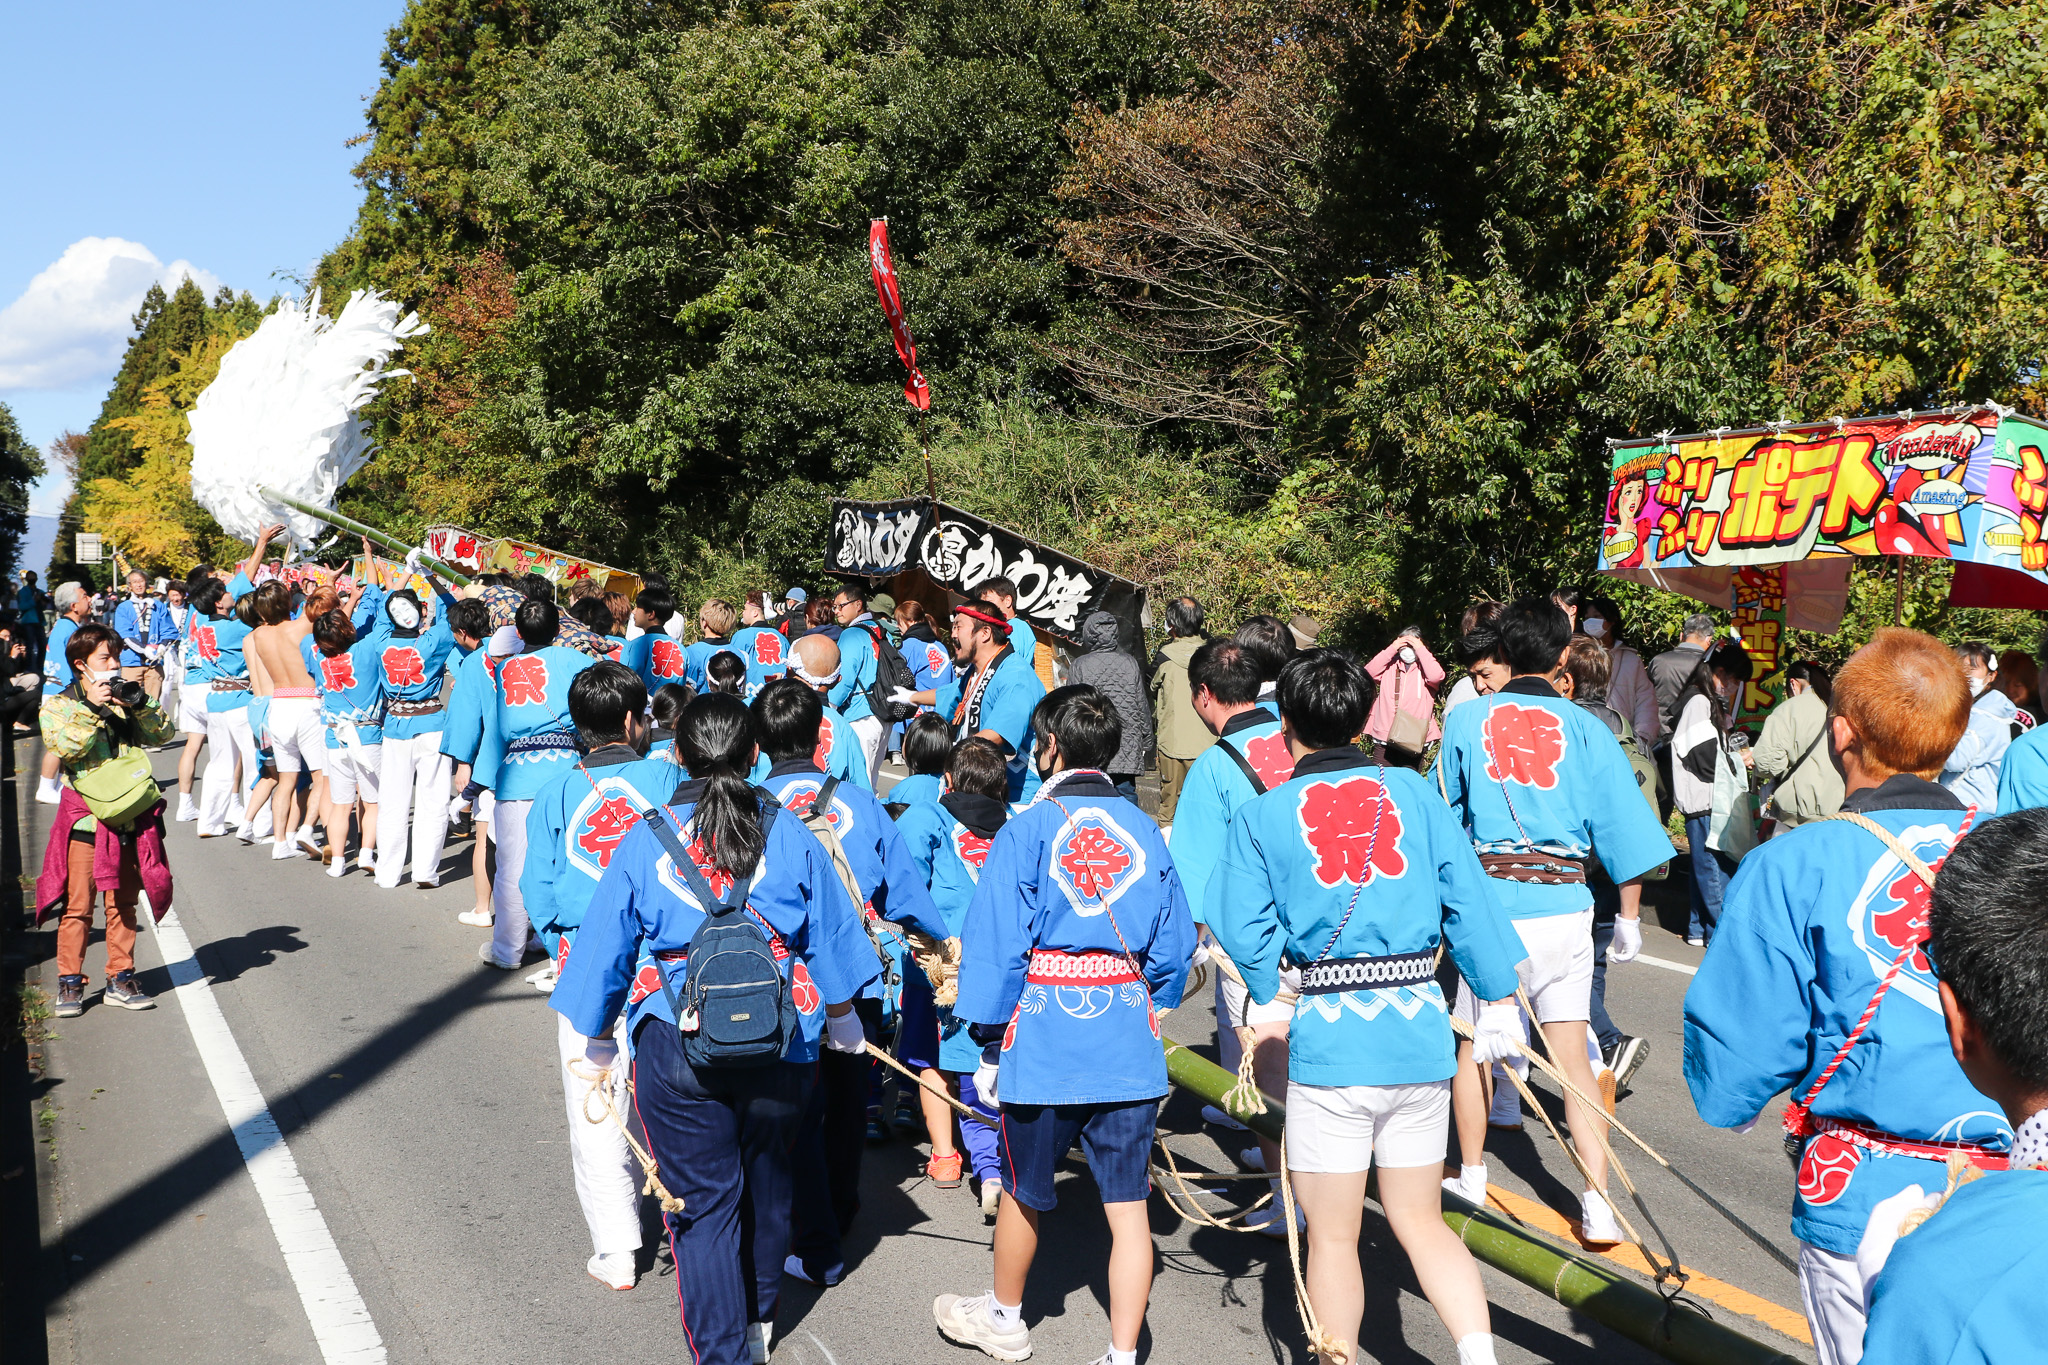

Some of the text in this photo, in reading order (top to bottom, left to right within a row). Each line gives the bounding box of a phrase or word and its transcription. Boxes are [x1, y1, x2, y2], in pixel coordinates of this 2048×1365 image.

[1886, 430, 1976, 463] Wonderful
[1656, 455, 1717, 506] ふり
[1720, 433, 1886, 545] ポテト
[1911, 488, 1966, 509] Amazing
[1656, 508, 1720, 561] ふり
[382, 646, 425, 686] 祭
[651, 639, 685, 678] 祭
[755, 631, 782, 665] 祭
[500, 654, 549, 706] 祭
[1484, 702, 1566, 788] 祭
[1298, 777, 1405, 886] 祭
[1060, 826, 1131, 898] 祭
